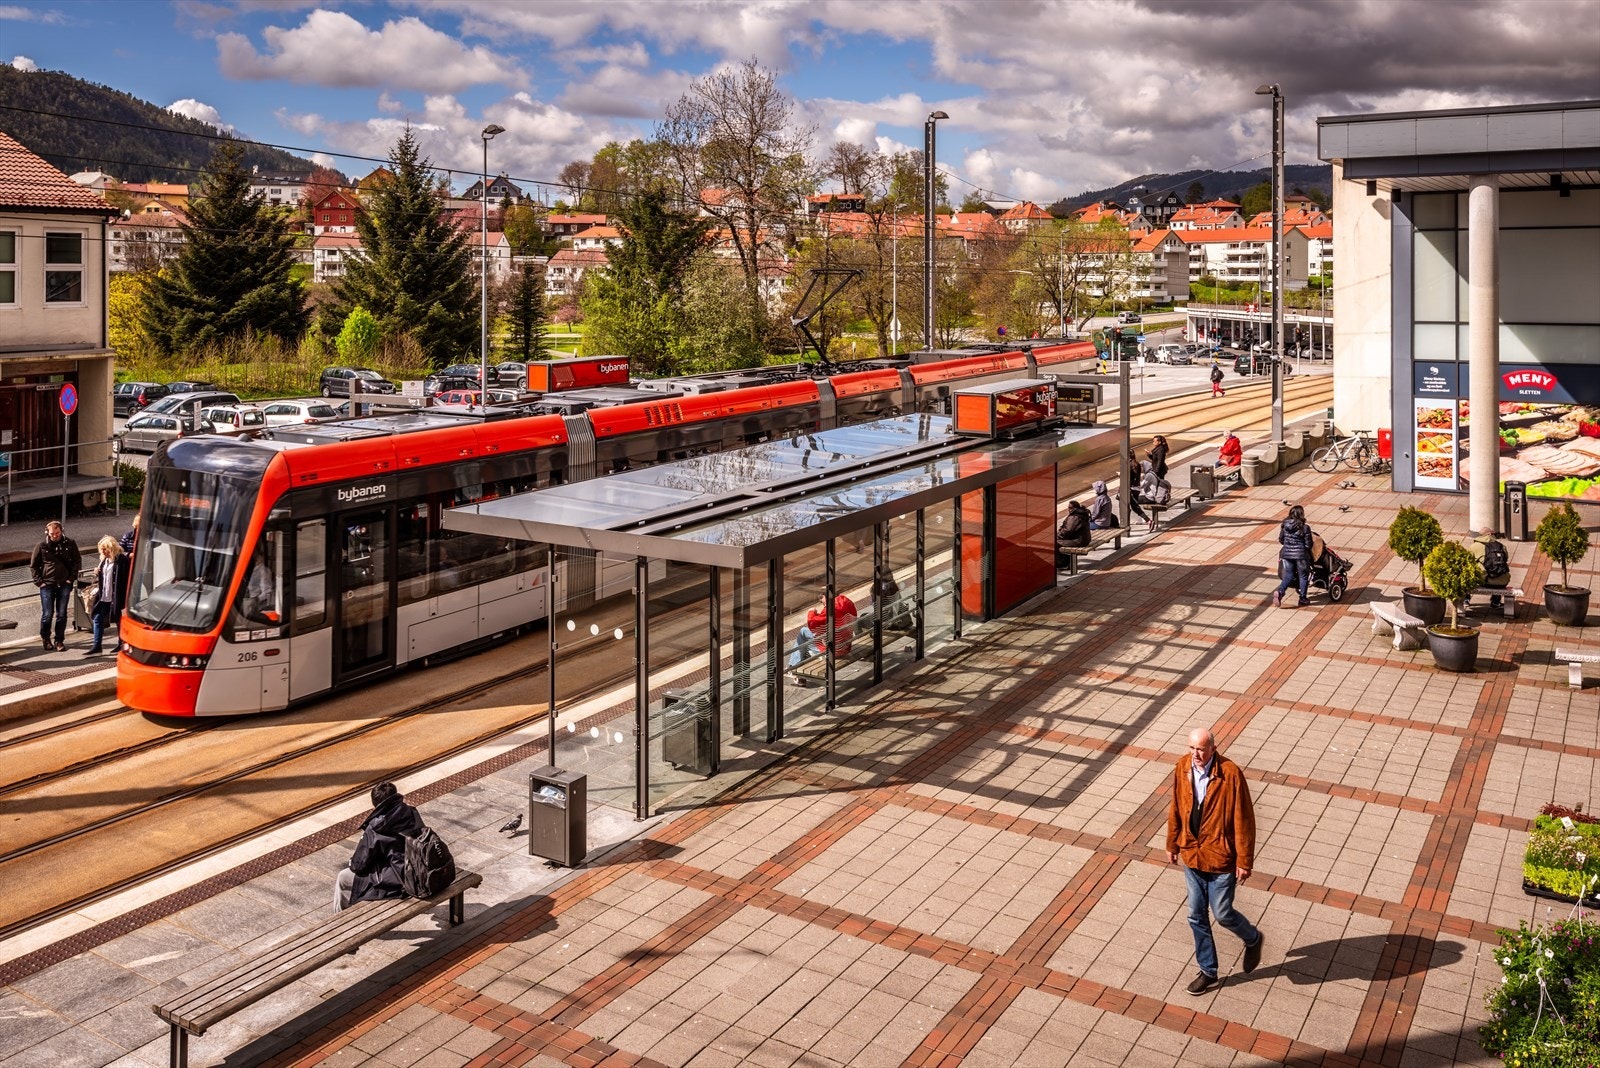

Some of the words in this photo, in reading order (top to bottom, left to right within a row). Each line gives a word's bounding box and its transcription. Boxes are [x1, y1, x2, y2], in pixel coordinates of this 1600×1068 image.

[600, 363, 629, 374] bybanen
[1509, 373, 1552, 386] MENY
[1036, 391, 1059, 403] bybanen
[338, 484, 386, 502] bybanen
[238, 651, 258, 663] 206
